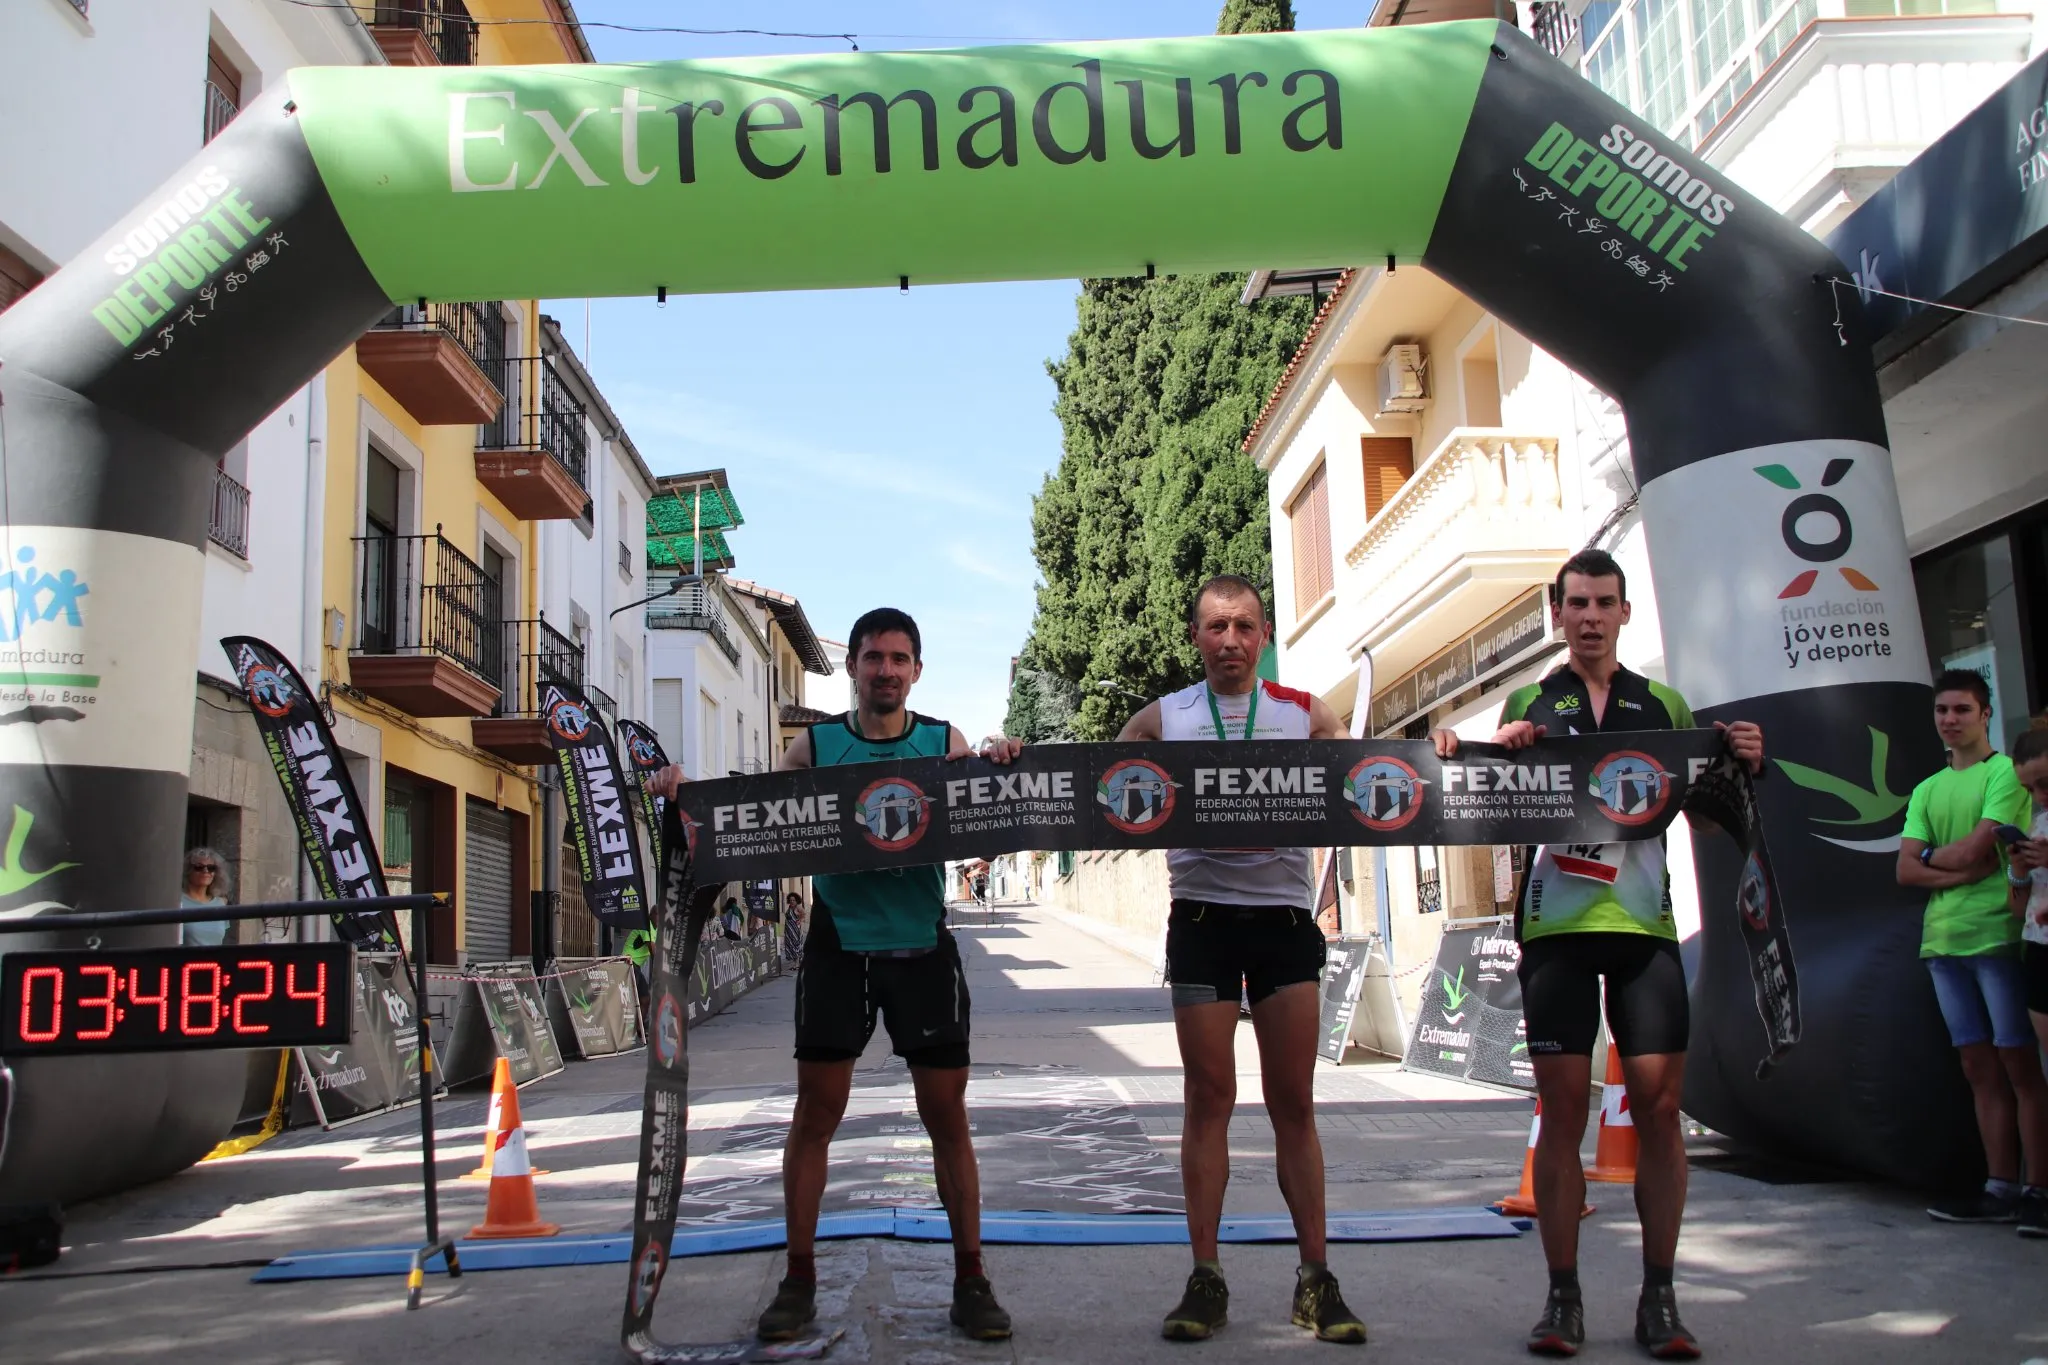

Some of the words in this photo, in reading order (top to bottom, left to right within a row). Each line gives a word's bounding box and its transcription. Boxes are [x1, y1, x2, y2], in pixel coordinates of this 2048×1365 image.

[447, 58, 1345, 193] Extremadura
[1600, 123, 1736, 226] SOMOS
[1524, 121, 1715, 272] DEPORTE
[104, 165, 231, 277] SOMOS
[92, 187, 272, 348] DEPORTE
[1780, 598, 1885, 623] fundación
[1496, 608, 1543, 651] COMPLEMENTOS
[1784, 620, 1890, 649] jóvenes
[1787, 650, 1799, 668] y
[1807, 641, 1892, 662] deporte
[41, 689, 55, 702] la
[62, 690, 97, 704] Base
[946, 771, 1075, 807] FEXME
[1194, 767, 1327, 795] FEXME
[1441, 764, 1573, 792] FEXME
[714, 794, 840, 831] FEXME
[949, 804, 1011, 820] FEDERACIÓN
[1015, 800, 1075, 812] EXTREMEÑA
[1195, 797, 1260, 809] FEDERACIÓN
[1264, 796, 1327, 808] EXTREMEÑA
[1443, 793, 1508, 806] FEDERACIÓN
[1513, 793, 1574, 805] EXTREMEÑA
[1443, 809, 1457, 820] DE
[1460, 807, 1510, 819] MONTAÑA
[1512, 808, 1518, 818] Y
[1521, 808, 1575, 818] ESCALADA
[950, 824, 963, 834] DE
[966, 817, 1013, 831] MONTAÑA
[1015, 816, 1021, 826] Y
[1023, 815, 1076, 825] ESCALADA
[1195, 812, 1209, 822] DE
[1211, 810, 1261, 822] MONTAÑA
[1263, 811, 1269, 821] Y
[1272, 811, 1327, 821] ESCALADA
[715, 829, 778, 844] FEDERACIÓN
[782, 823, 841, 838] EXTREMEÑA
[716, 847, 730, 857] DE
[732, 842, 780, 856] MONTAÑA
[782, 842, 788, 852] Y
[790, 837, 843, 851] ESCALADA
[662, 848, 689, 973] FEXME
[1481, 936, 1522, 959] Interreg
[20, 960, 328, 1043] 03:48:24
[645, 1090, 668, 1221] FEXME
